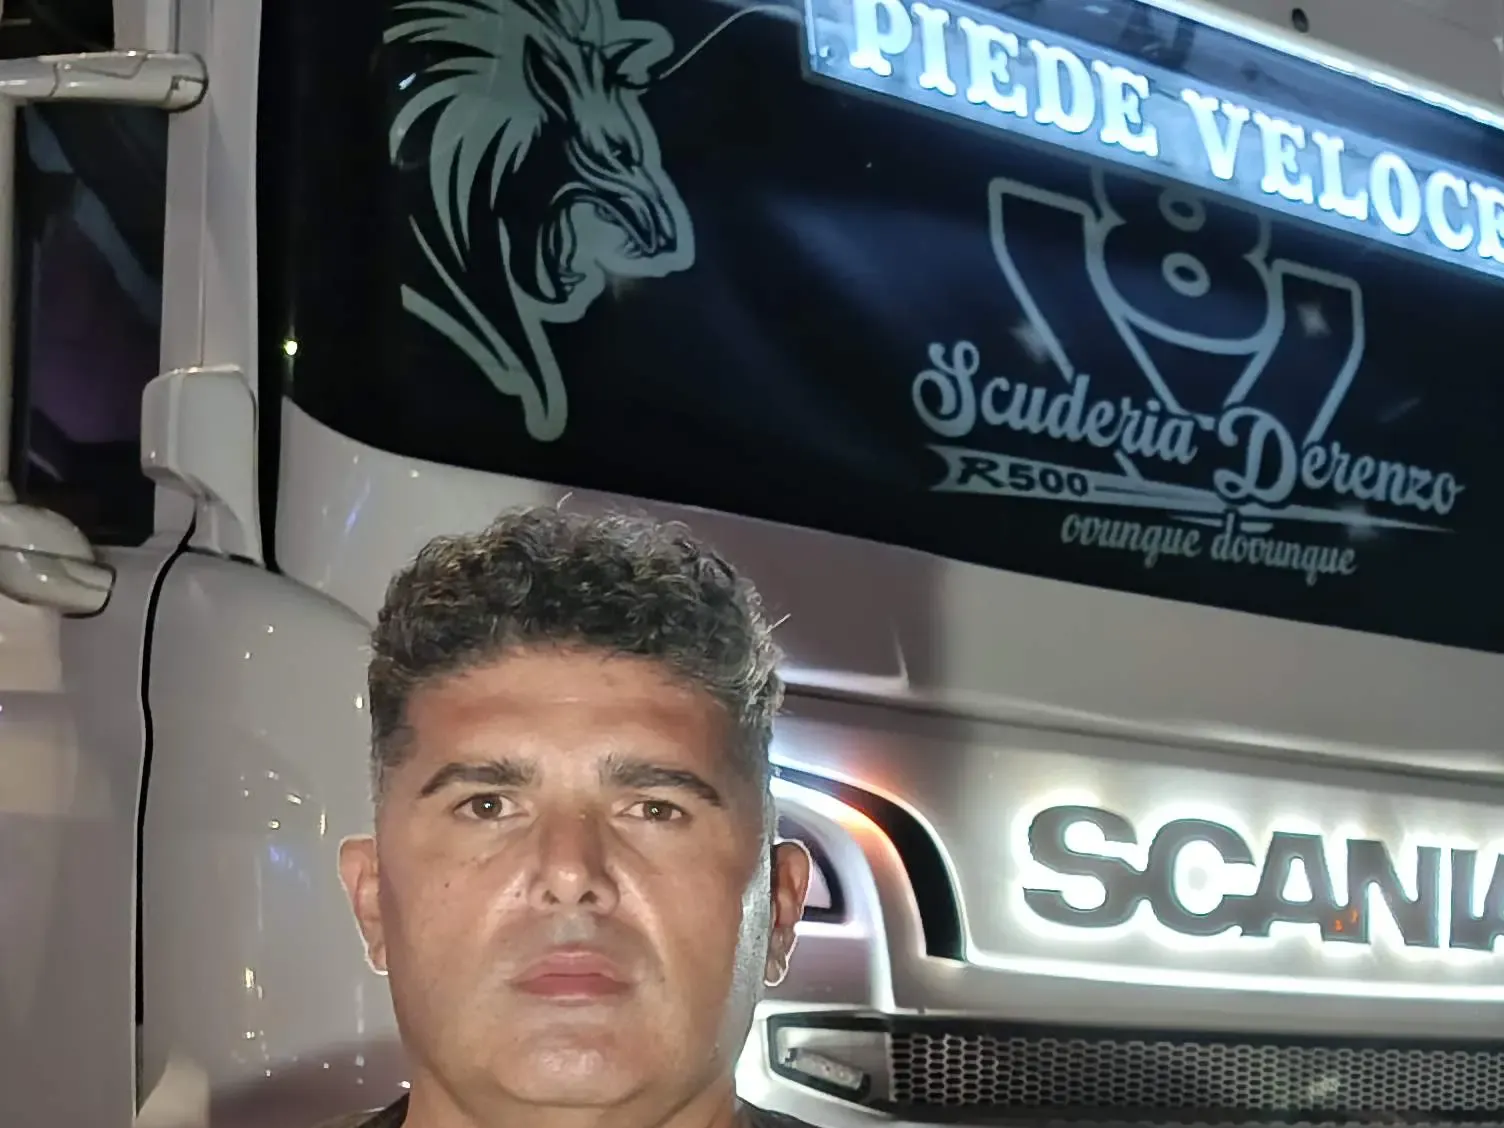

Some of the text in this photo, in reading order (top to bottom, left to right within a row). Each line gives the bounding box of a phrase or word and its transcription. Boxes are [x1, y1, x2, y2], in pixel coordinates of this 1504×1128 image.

[848, 0, 1159, 157] PIEDE
[912, 341, 1466, 515] Scuderia Derenzo
[956, 455, 1089, 497] R500
[1061, 511, 1358, 586] ovunque dovunque
